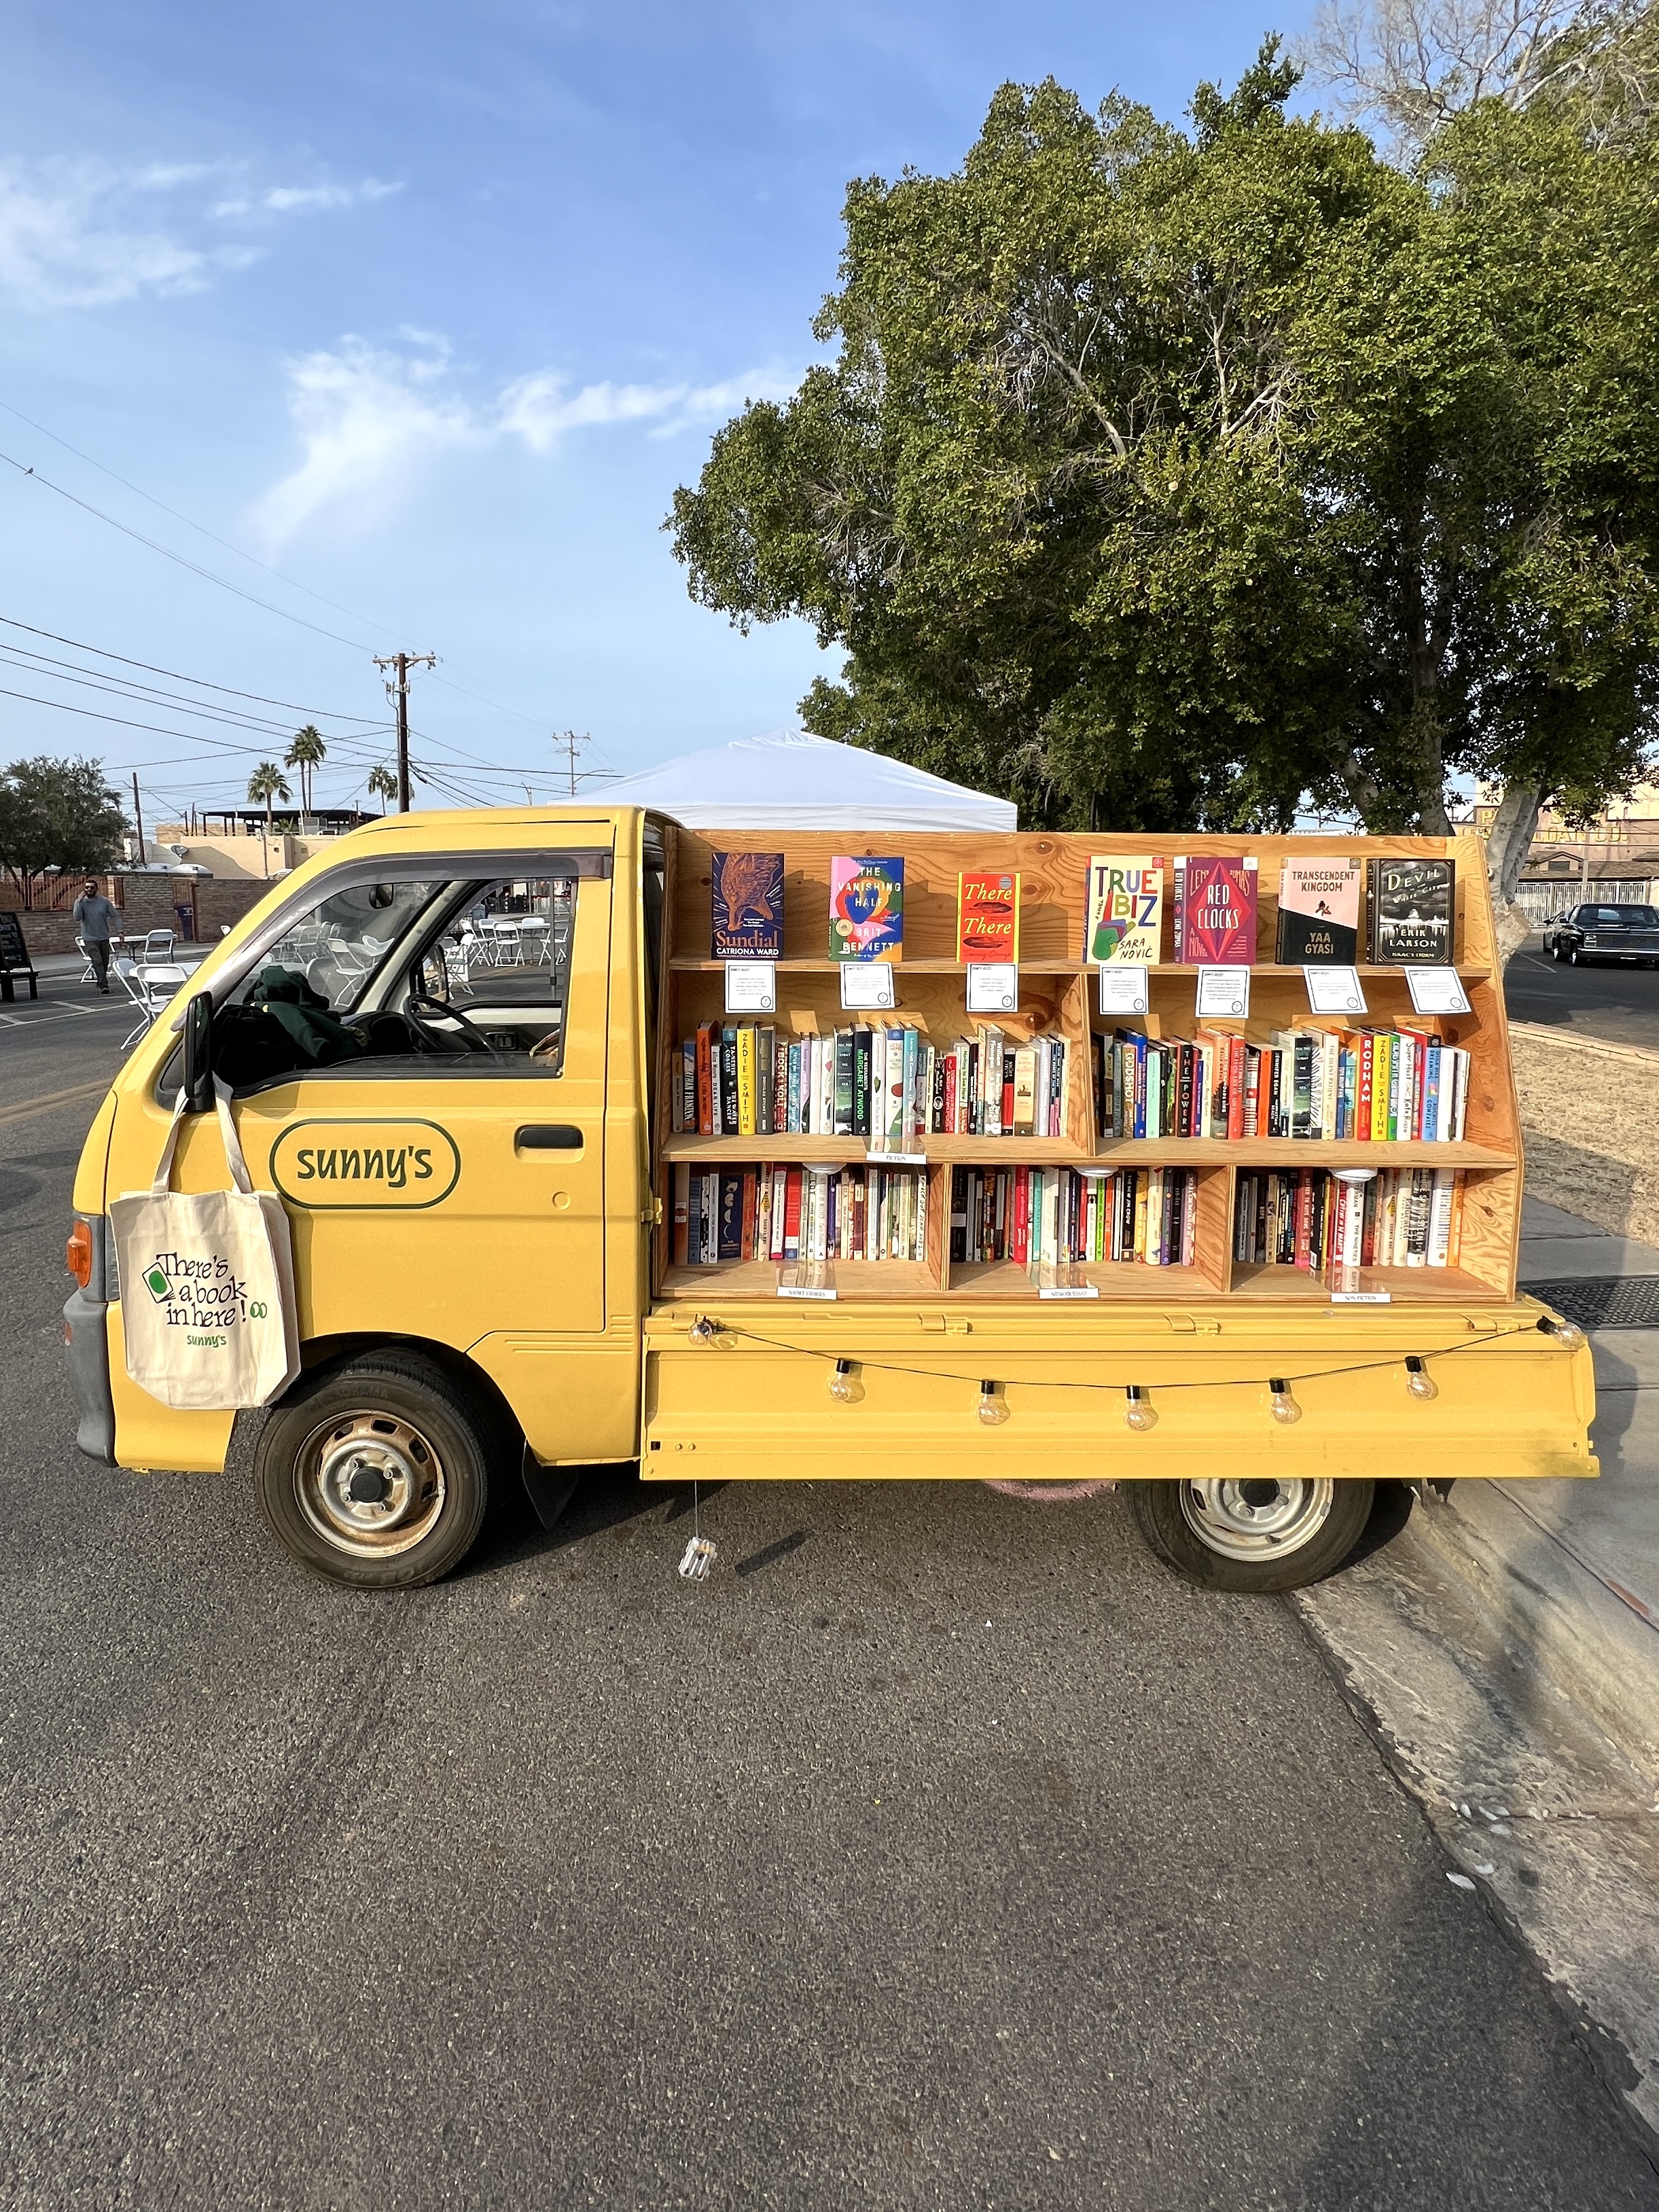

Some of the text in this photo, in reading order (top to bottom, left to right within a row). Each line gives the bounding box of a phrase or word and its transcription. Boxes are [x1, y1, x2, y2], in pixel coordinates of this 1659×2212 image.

[859, 867, 880, 876] THE
[1292, 871, 1355, 880] TRANSCENDENT
[1388, 869, 1440, 891] DEVIL
[838, 882, 901, 891] VANISHING
[1095, 867, 1158, 897] TRUE
[1301, 882, 1342, 892] KINGDOM
[965, 883, 1012, 900] There
[1207, 885, 1230, 905] RED
[855, 897, 883, 907] HALF
[1115, 895, 1158, 927] BIZ
[1198, 909, 1238, 929] CLOCKS
[856, 928, 881, 937] BRIT
[963, 916, 1012, 934] There
[1190, 927, 1195, 936] A
[717, 929, 778, 948] Sundial
[1118, 938, 1145, 950] SARA
[1310, 932, 1331, 943] YAA
[1389, 940, 1438, 948] LARSON
[717, 947, 754, 955] CATRIONA
[842, 942, 894, 951] BENNETT
[1120, 945, 1154, 960] NOVIĆ
[1189, 937, 1208, 957] NOVEL
[1305, 944, 1334, 955] GYASI
[1406, 1043, 1414, 1060] Super
[1125, 1052, 1134, 1103] GODSHOT
[1361, 1039, 1372, 1102] RODHAM
[1181, 1084, 1190, 1125] POWER
[1377, 1088, 1385, 1128] SMITH
[297, 1145, 433, 1188] sunny's
[1403, 1198, 1411, 1238] Educated
[156, 1251, 228, 1279] There's
[179, 1274, 248, 1304] a book
[166, 1302, 190, 1325] in
[187, 1334, 227, 1348] sunny's
